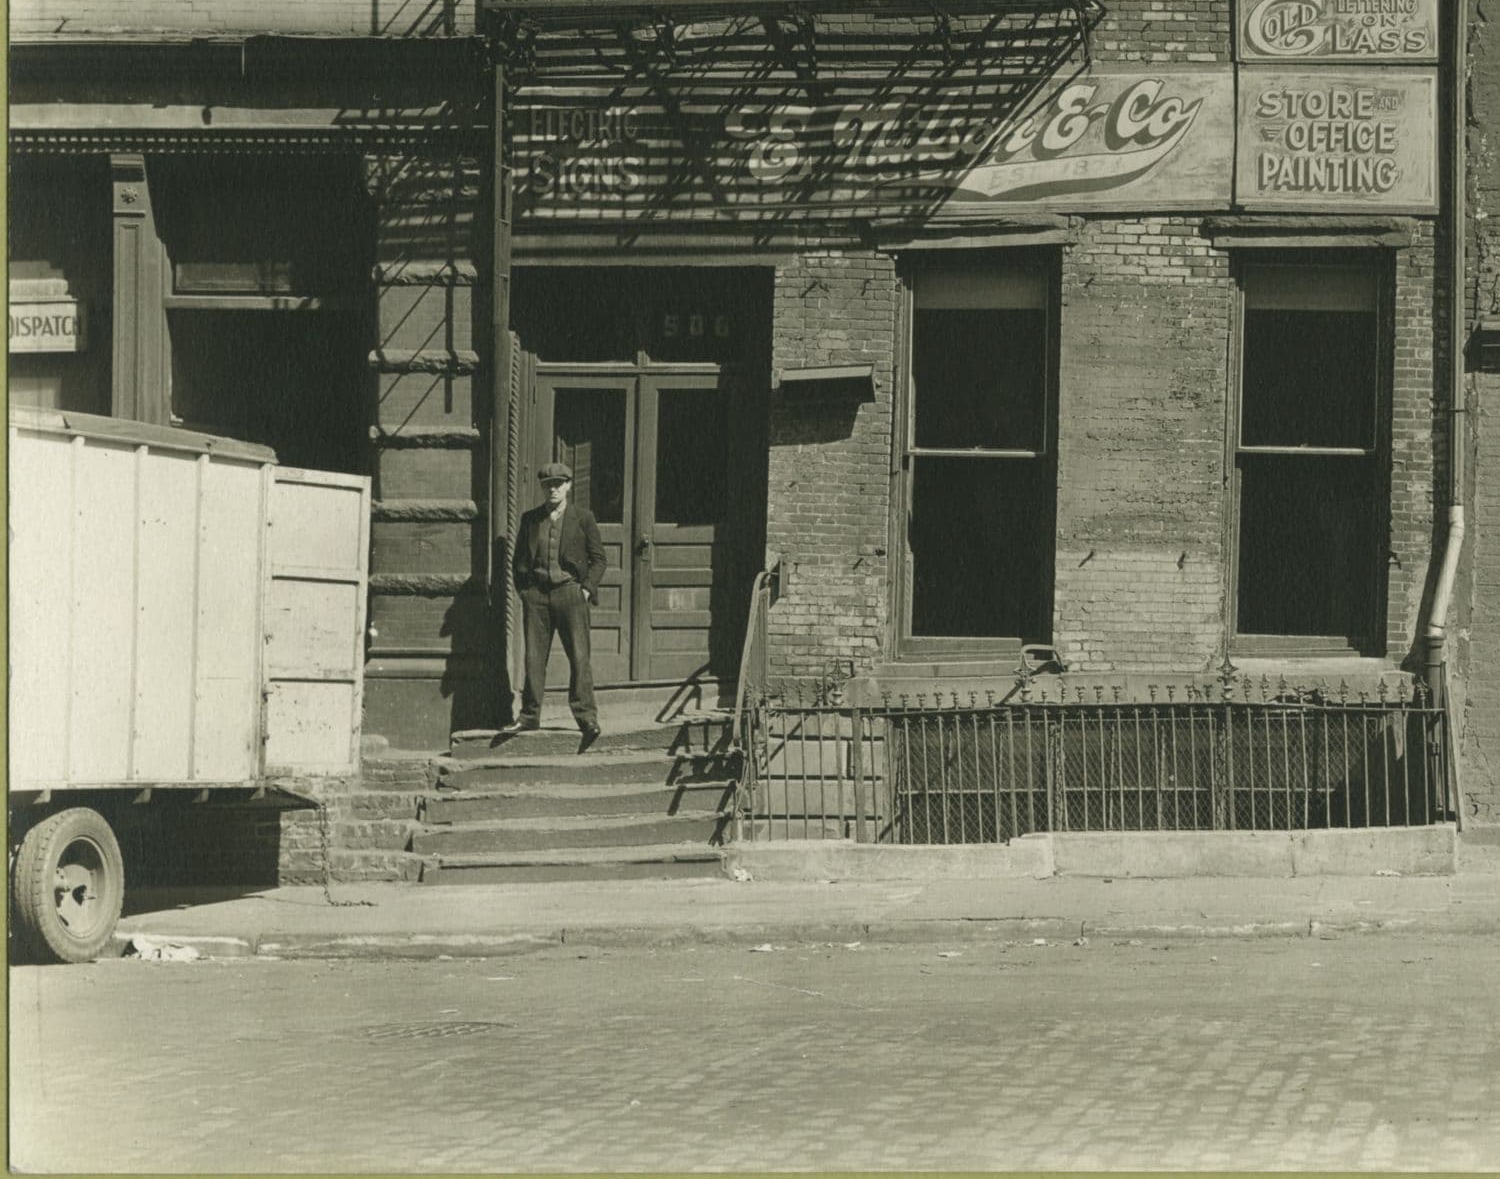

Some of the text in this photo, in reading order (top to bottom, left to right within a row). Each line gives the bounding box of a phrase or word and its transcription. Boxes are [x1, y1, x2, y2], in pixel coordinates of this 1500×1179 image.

[1361, 14, 1397, 28] ON
[1256, 88, 1399, 119] STORE AND
[530, 107, 638, 140] ELECTRIC
[1285, 121, 1398, 153] OFFICE
[532, 155, 641, 193] SIGNS
[1257, 153, 1400, 193] PAINTING
